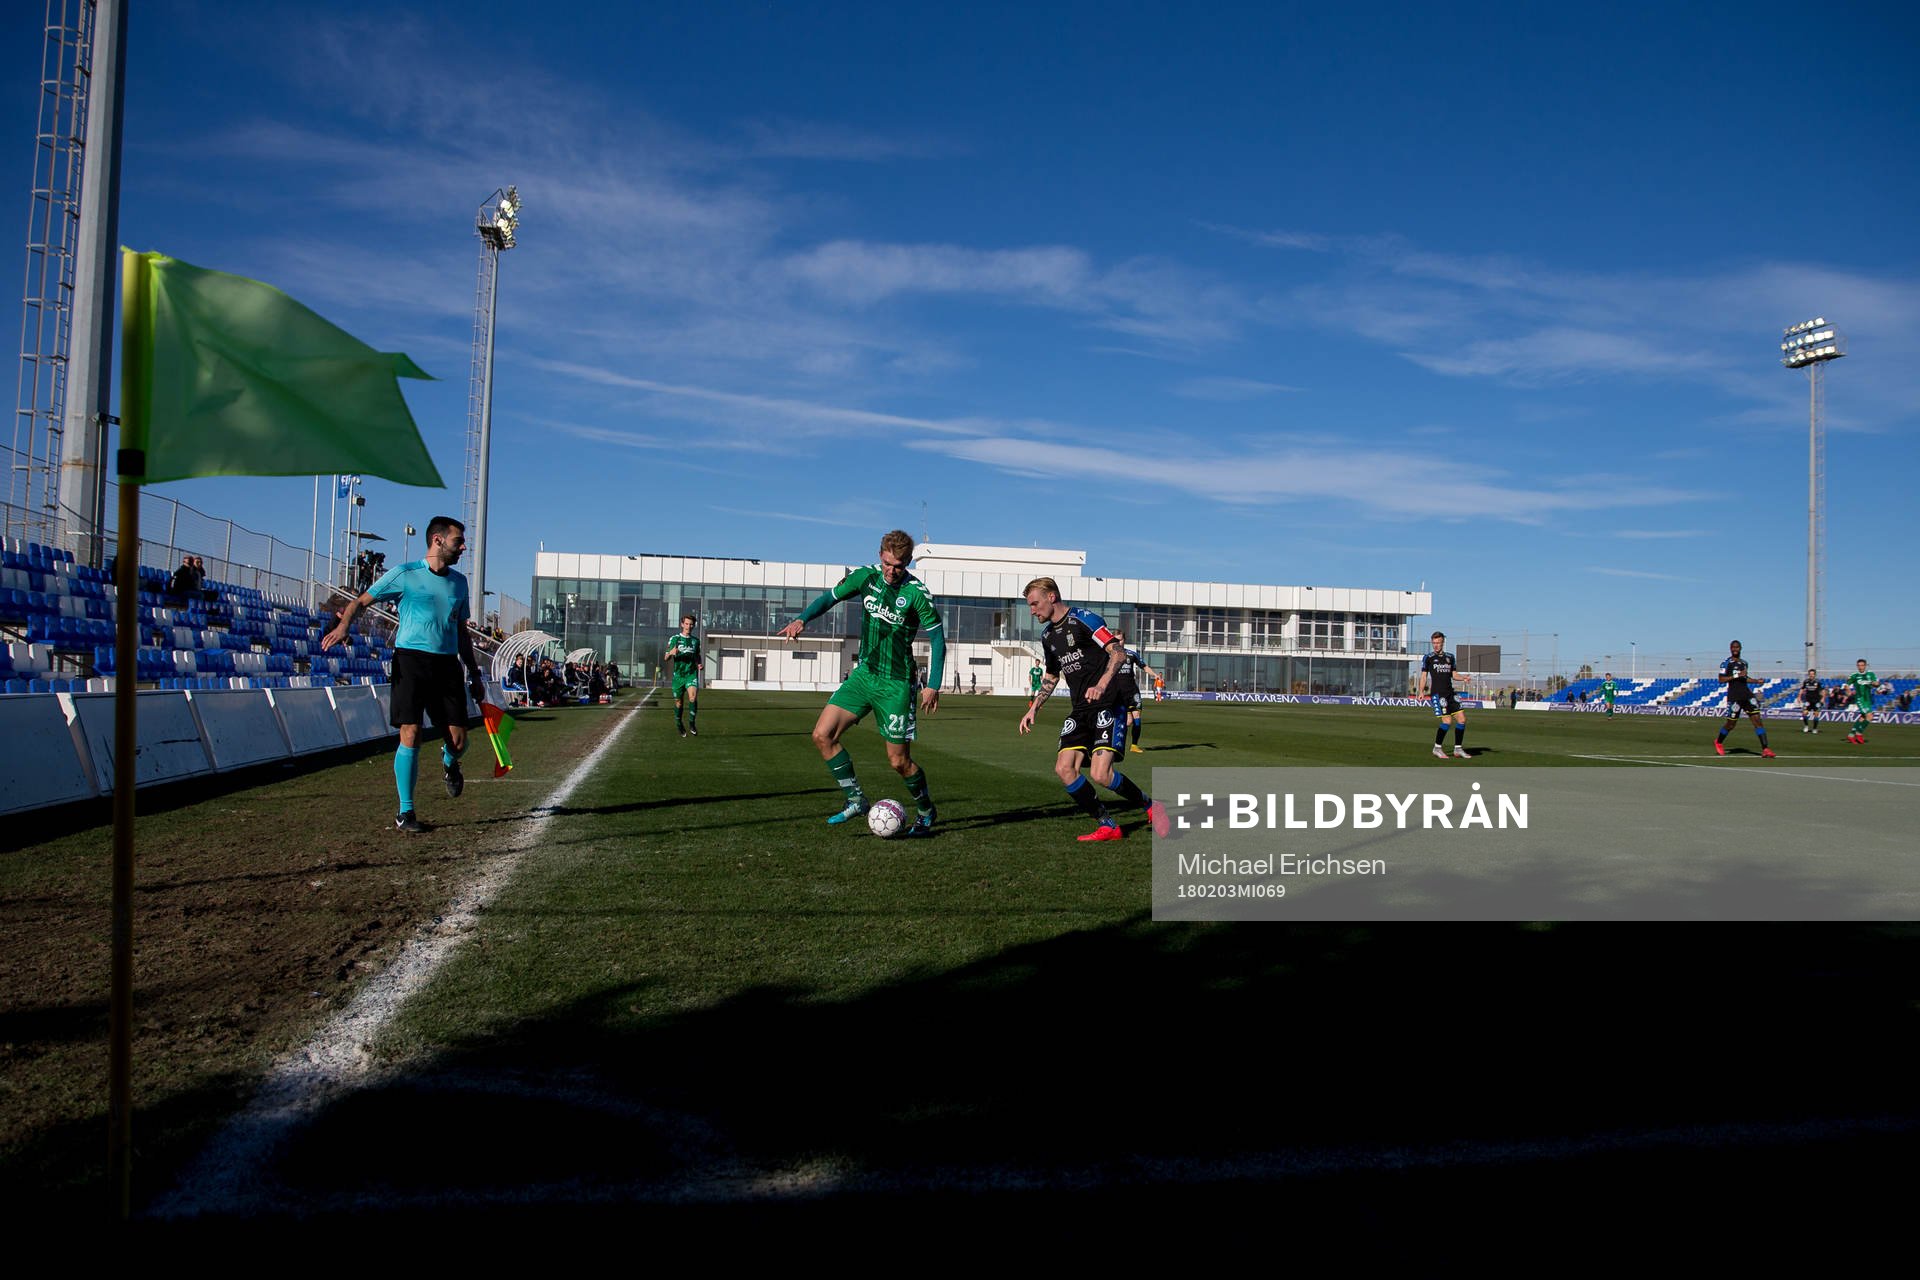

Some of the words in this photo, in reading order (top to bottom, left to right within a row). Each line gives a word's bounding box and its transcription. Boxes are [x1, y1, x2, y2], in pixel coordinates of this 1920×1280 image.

[863, 594, 905, 625] Carlsberg
[889, 713, 905, 731] 21
[1101, 730, 1109, 739] 6
